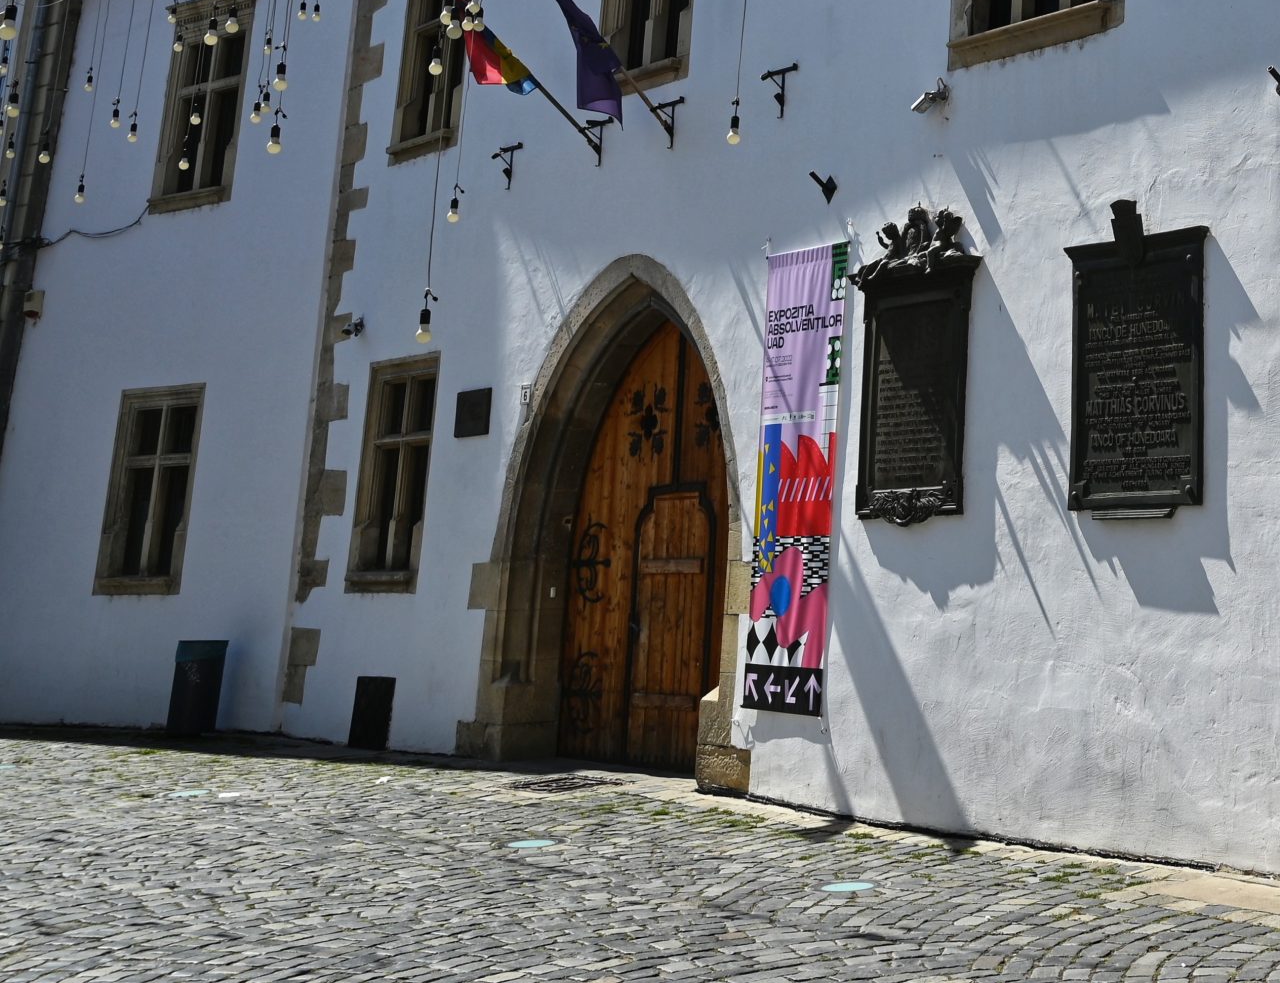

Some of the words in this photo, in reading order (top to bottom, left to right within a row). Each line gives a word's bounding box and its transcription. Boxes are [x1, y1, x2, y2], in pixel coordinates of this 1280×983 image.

[1089, 326, 1113, 341] IANCU
[1115, 324, 1127, 337] DE
[767, 336, 785, 349] UAD
[523, 390, 528, 402] 6
[1086, 397, 1132, 416] MATTHIAS
[1135, 392, 1185, 413] CORVINUS
[1090, 432, 1113, 447] IANCU
[1115, 432, 1127, 446] OF
[1128, 429, 1176, 445] HUNEDOARA
